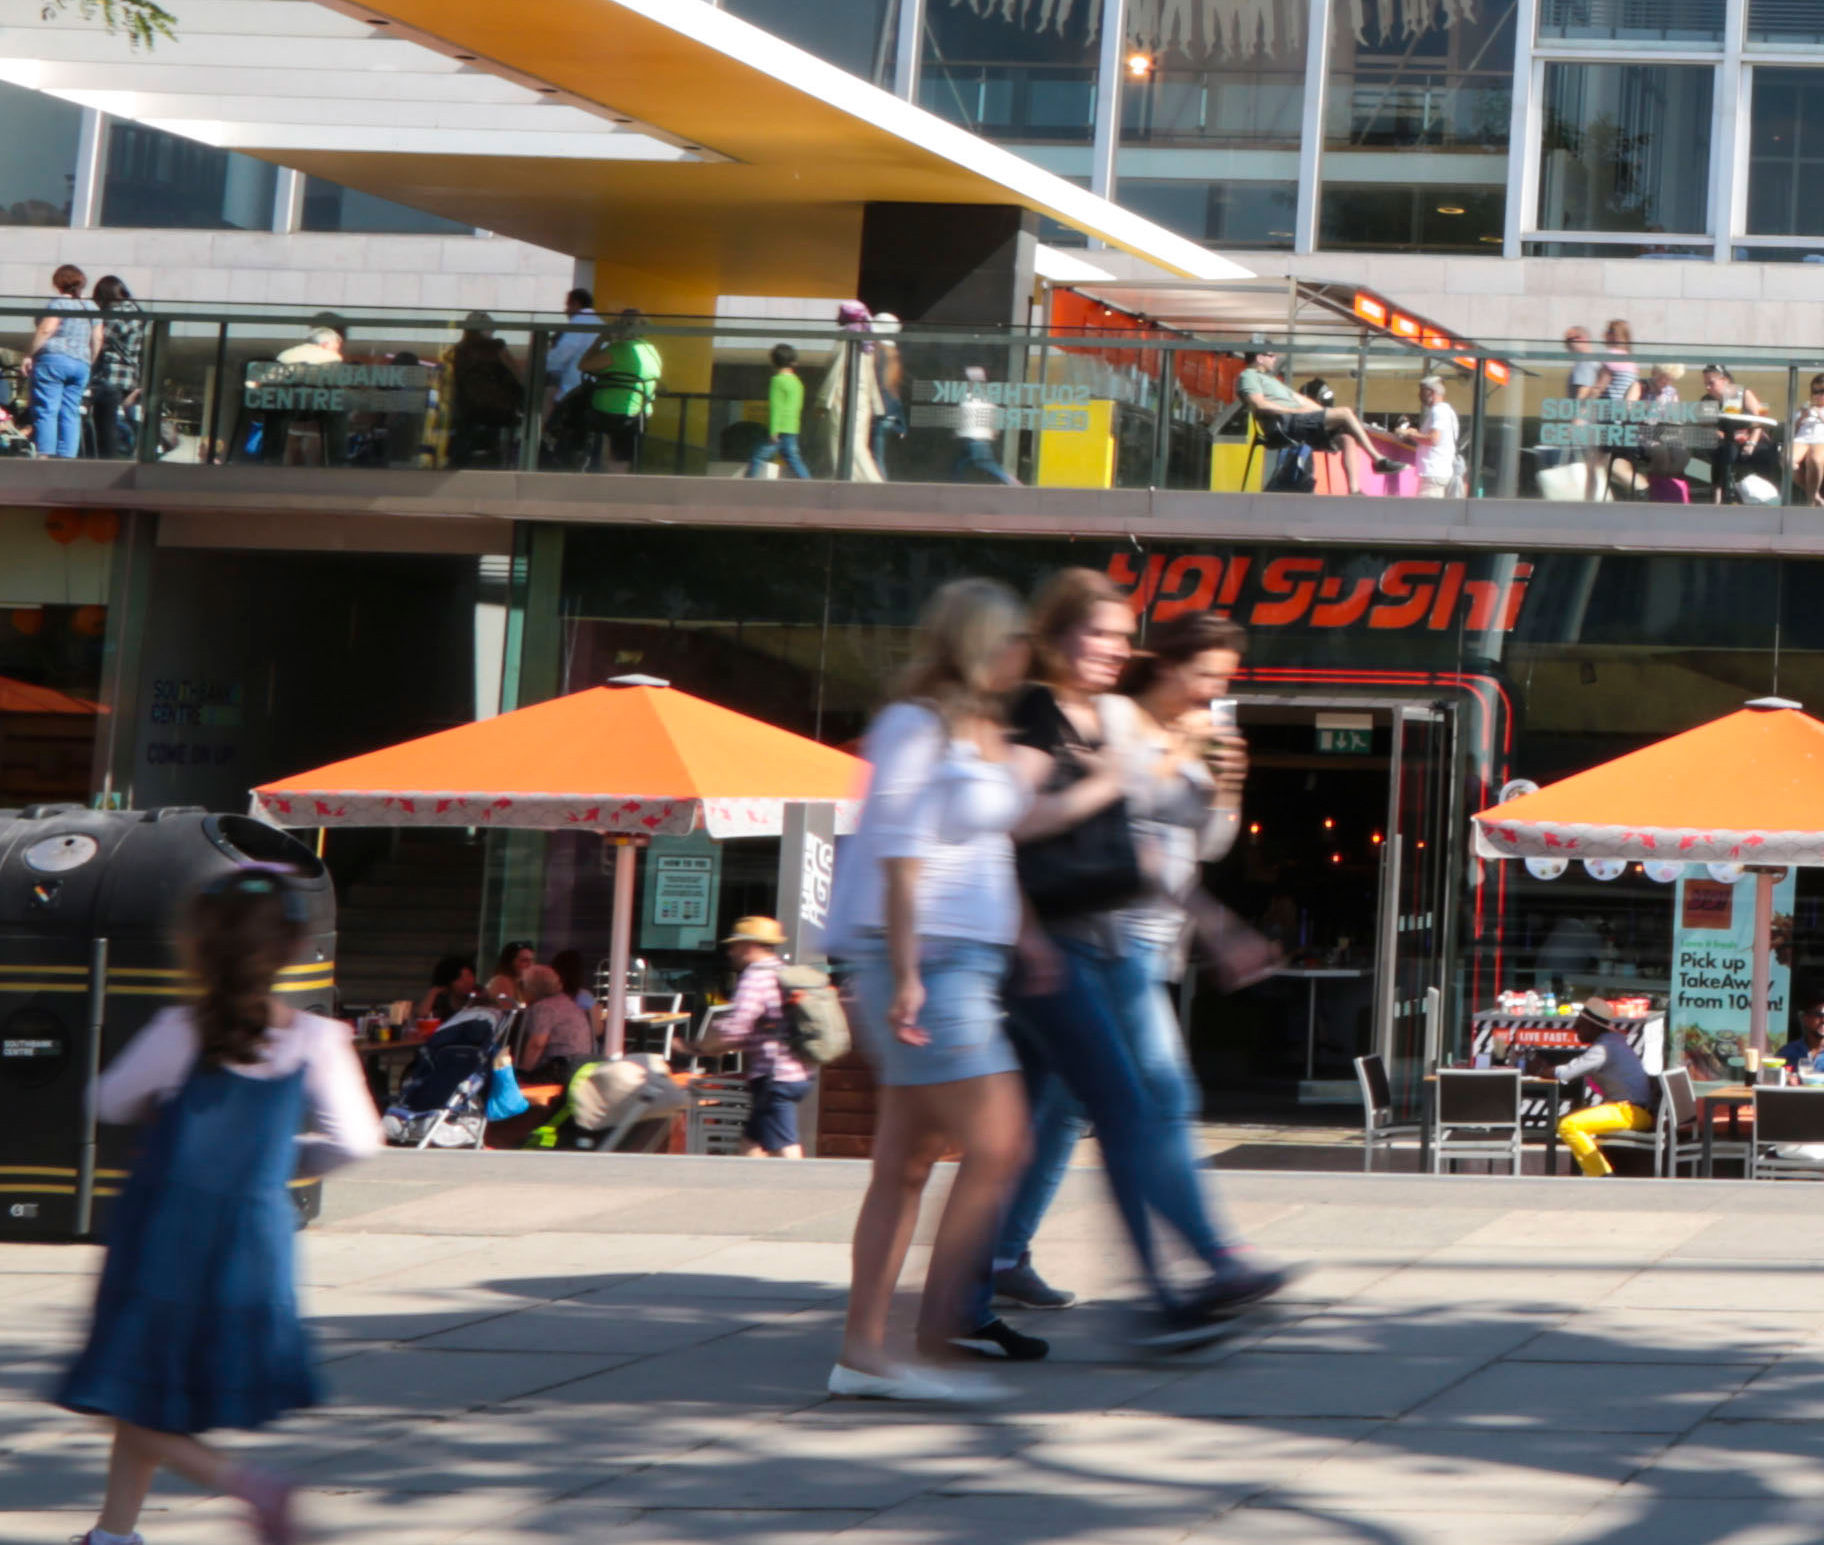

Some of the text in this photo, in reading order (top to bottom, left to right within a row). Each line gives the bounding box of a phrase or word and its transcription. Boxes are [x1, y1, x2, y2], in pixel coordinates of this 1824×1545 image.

[245, 387, 345, 410] CENTRE
[1541, 398, 1697, 423] SOUTHBANK
[1540, 422, 1640, 447] CENTRE
[1680, 951, 1746, 973] Pick up
[1678, 991, 1783, 1011] from 10m!
[1519, 1032, 1540, 1042] LIVE
